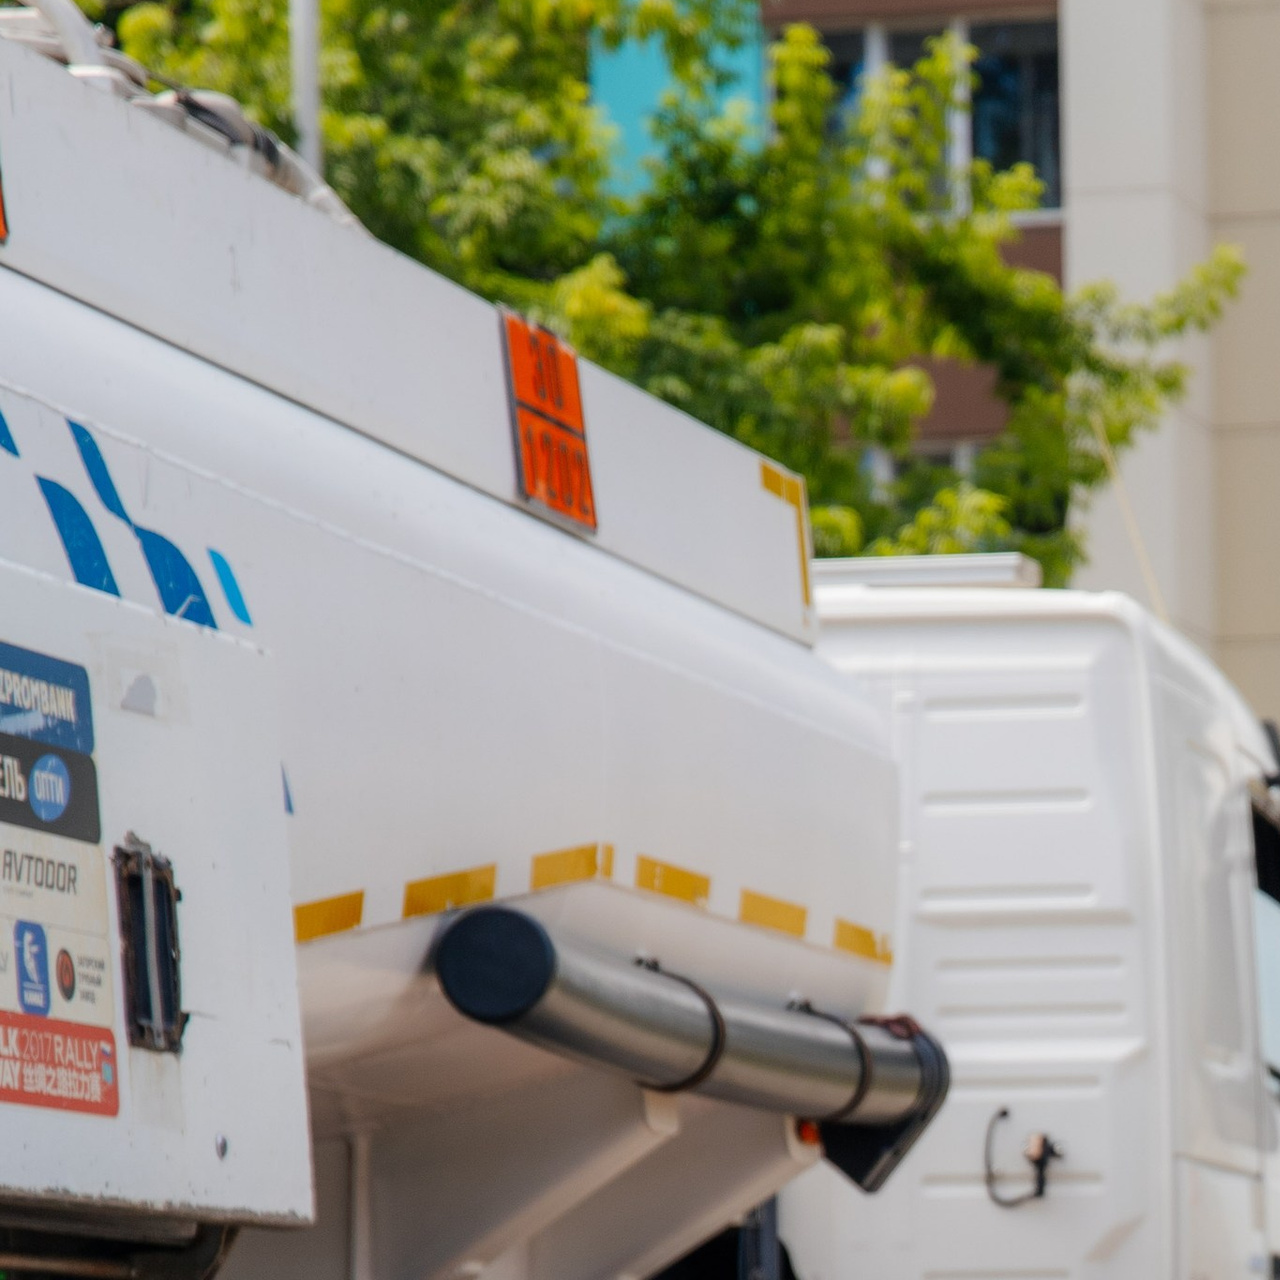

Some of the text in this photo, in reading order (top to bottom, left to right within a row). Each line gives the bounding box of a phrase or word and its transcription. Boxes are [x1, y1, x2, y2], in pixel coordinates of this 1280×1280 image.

[525, 424, 590, 516] 1202
[2, 850, 77, 894] AVTODOR
[21, 1029, 53, 1063] 2017
[54, 1033, 98, 1070] RALLY
